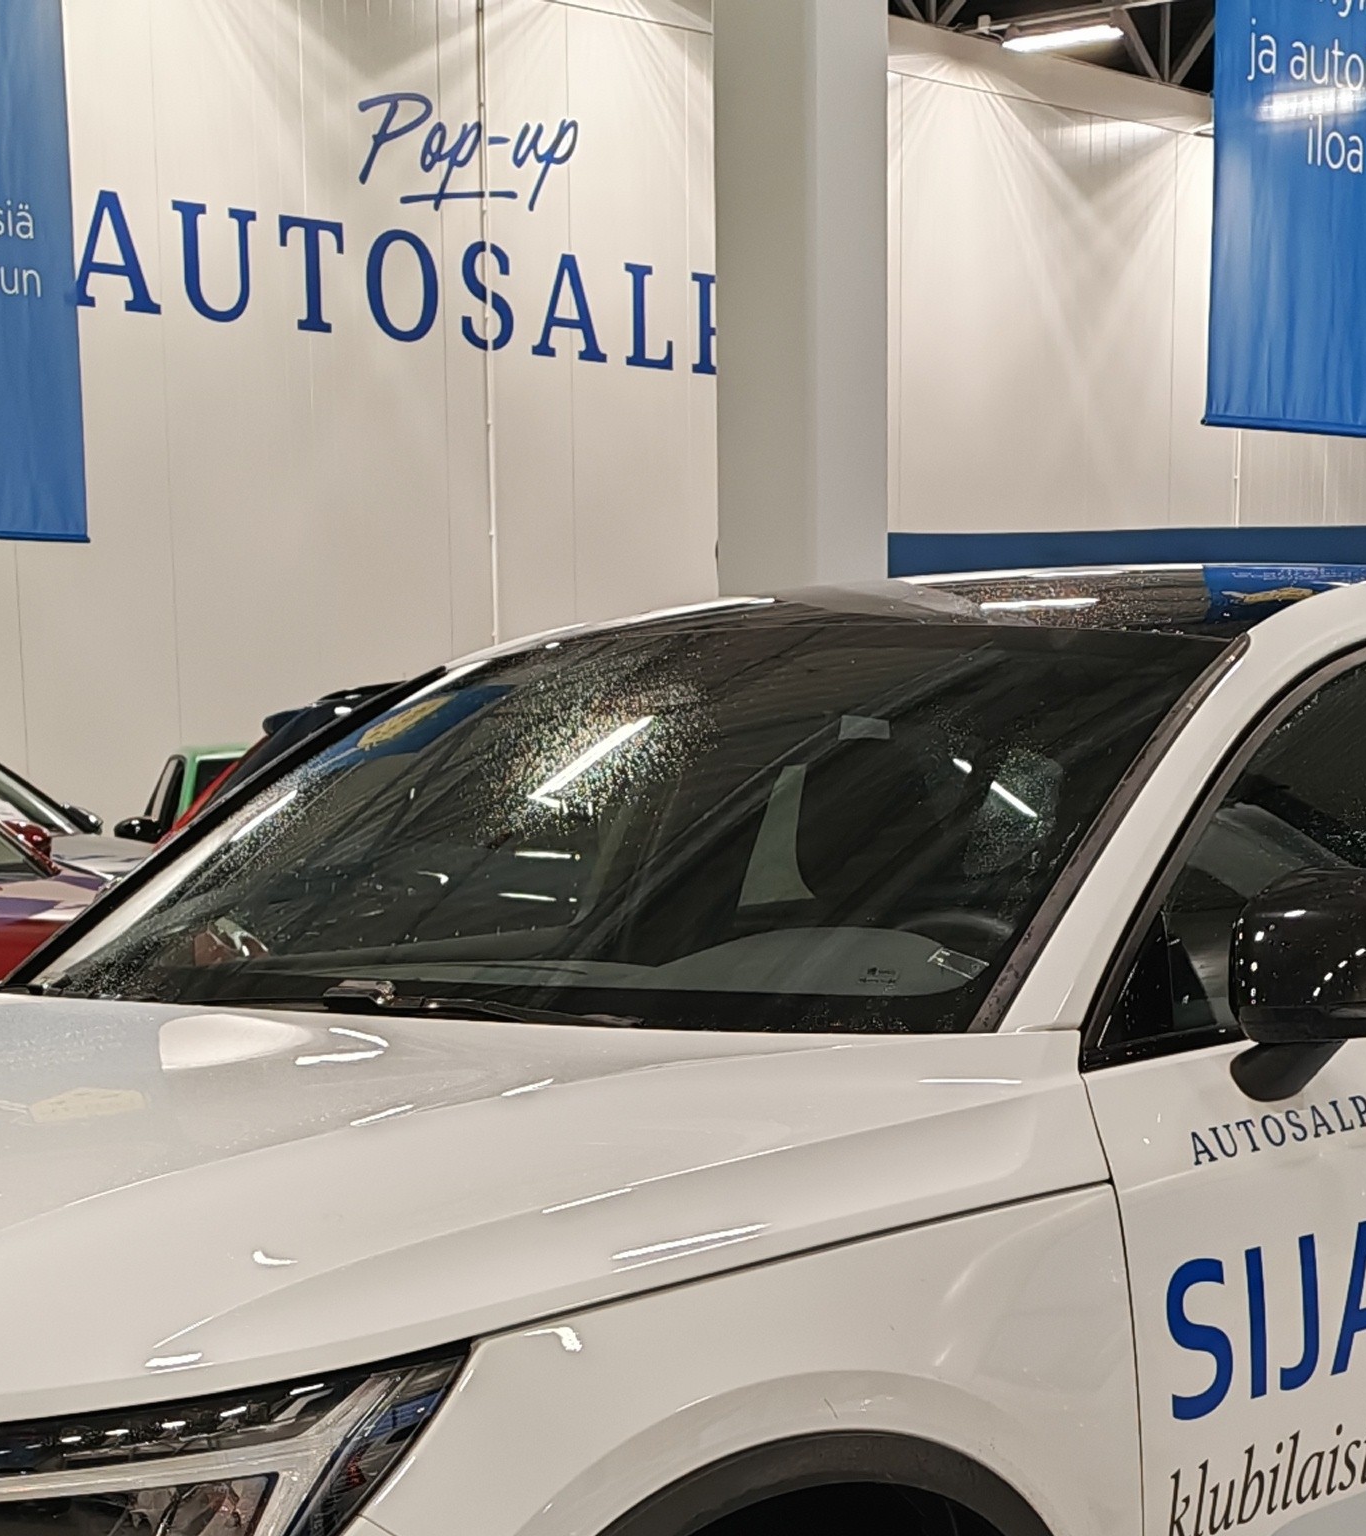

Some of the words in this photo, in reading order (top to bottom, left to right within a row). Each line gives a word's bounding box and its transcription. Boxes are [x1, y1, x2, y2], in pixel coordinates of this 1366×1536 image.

[1246, 17, 1277, 82] ja
[358, 91, 580, 211] Pop-up
[1307, 113, 1364, 174] iloa
